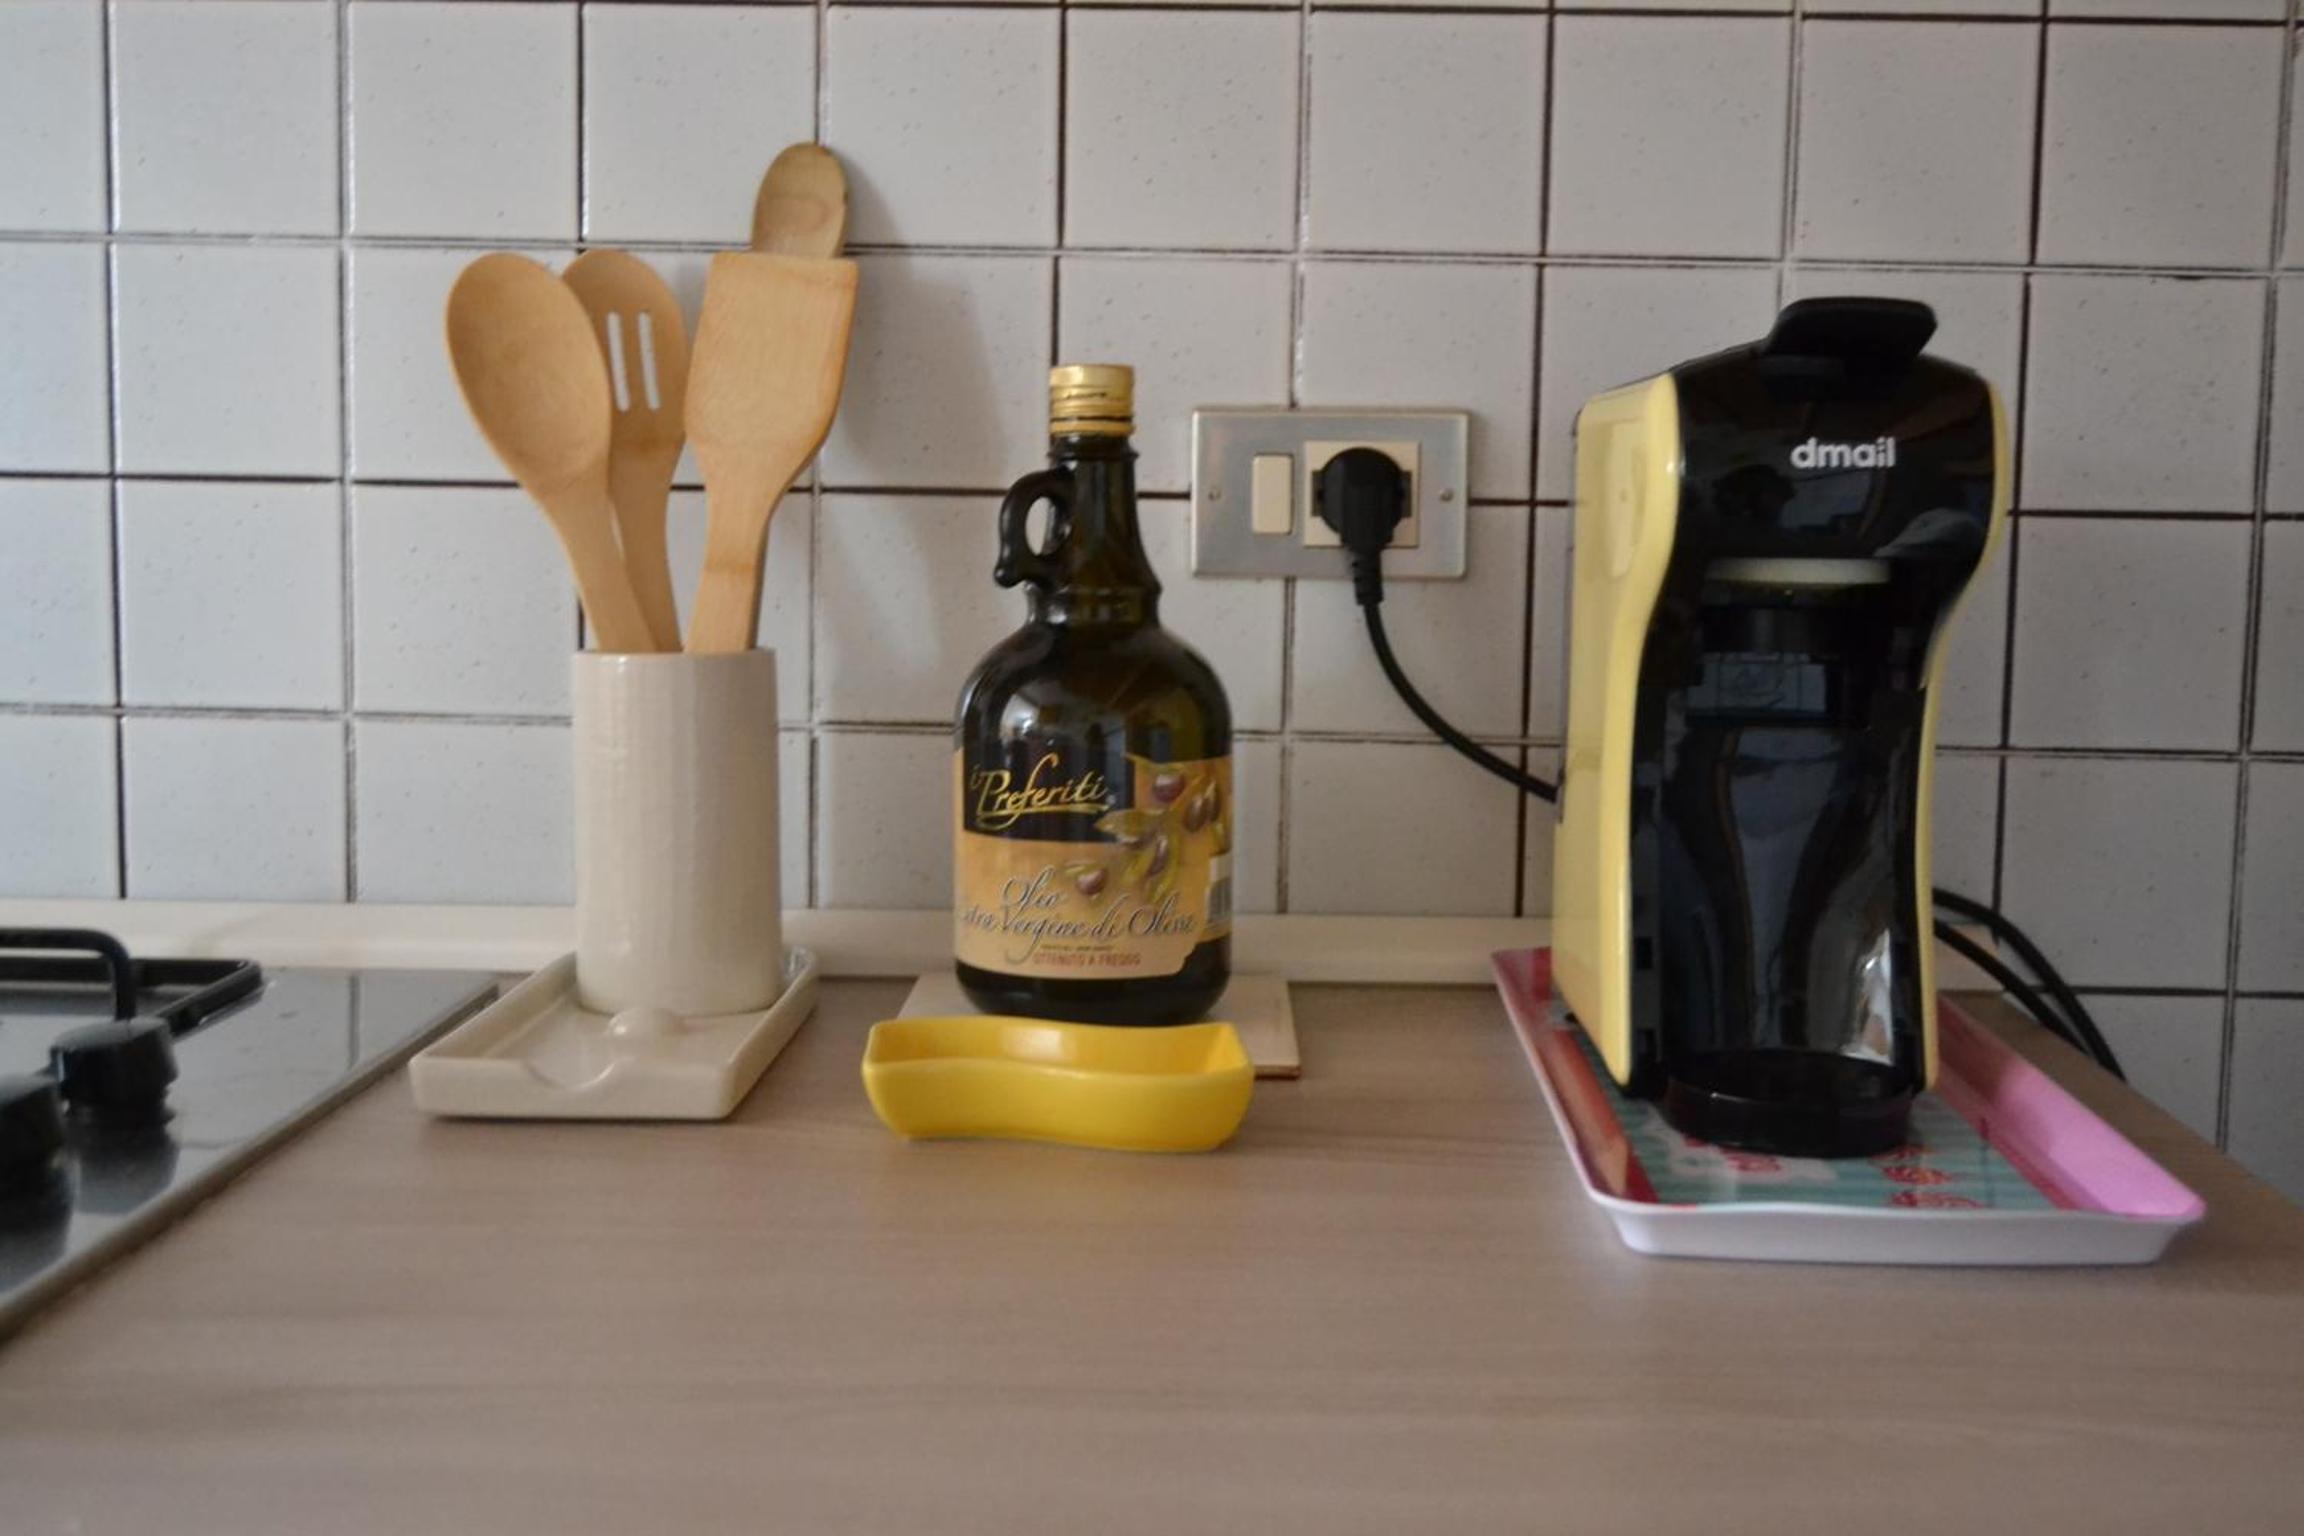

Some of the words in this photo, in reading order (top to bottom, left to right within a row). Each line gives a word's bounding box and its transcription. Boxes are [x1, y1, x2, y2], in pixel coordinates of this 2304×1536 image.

[1790, 436, 1896, 468] dmail
[976, 752, 1110, 831] Preferiti
[1002, 866, 1066, 910] Olio
